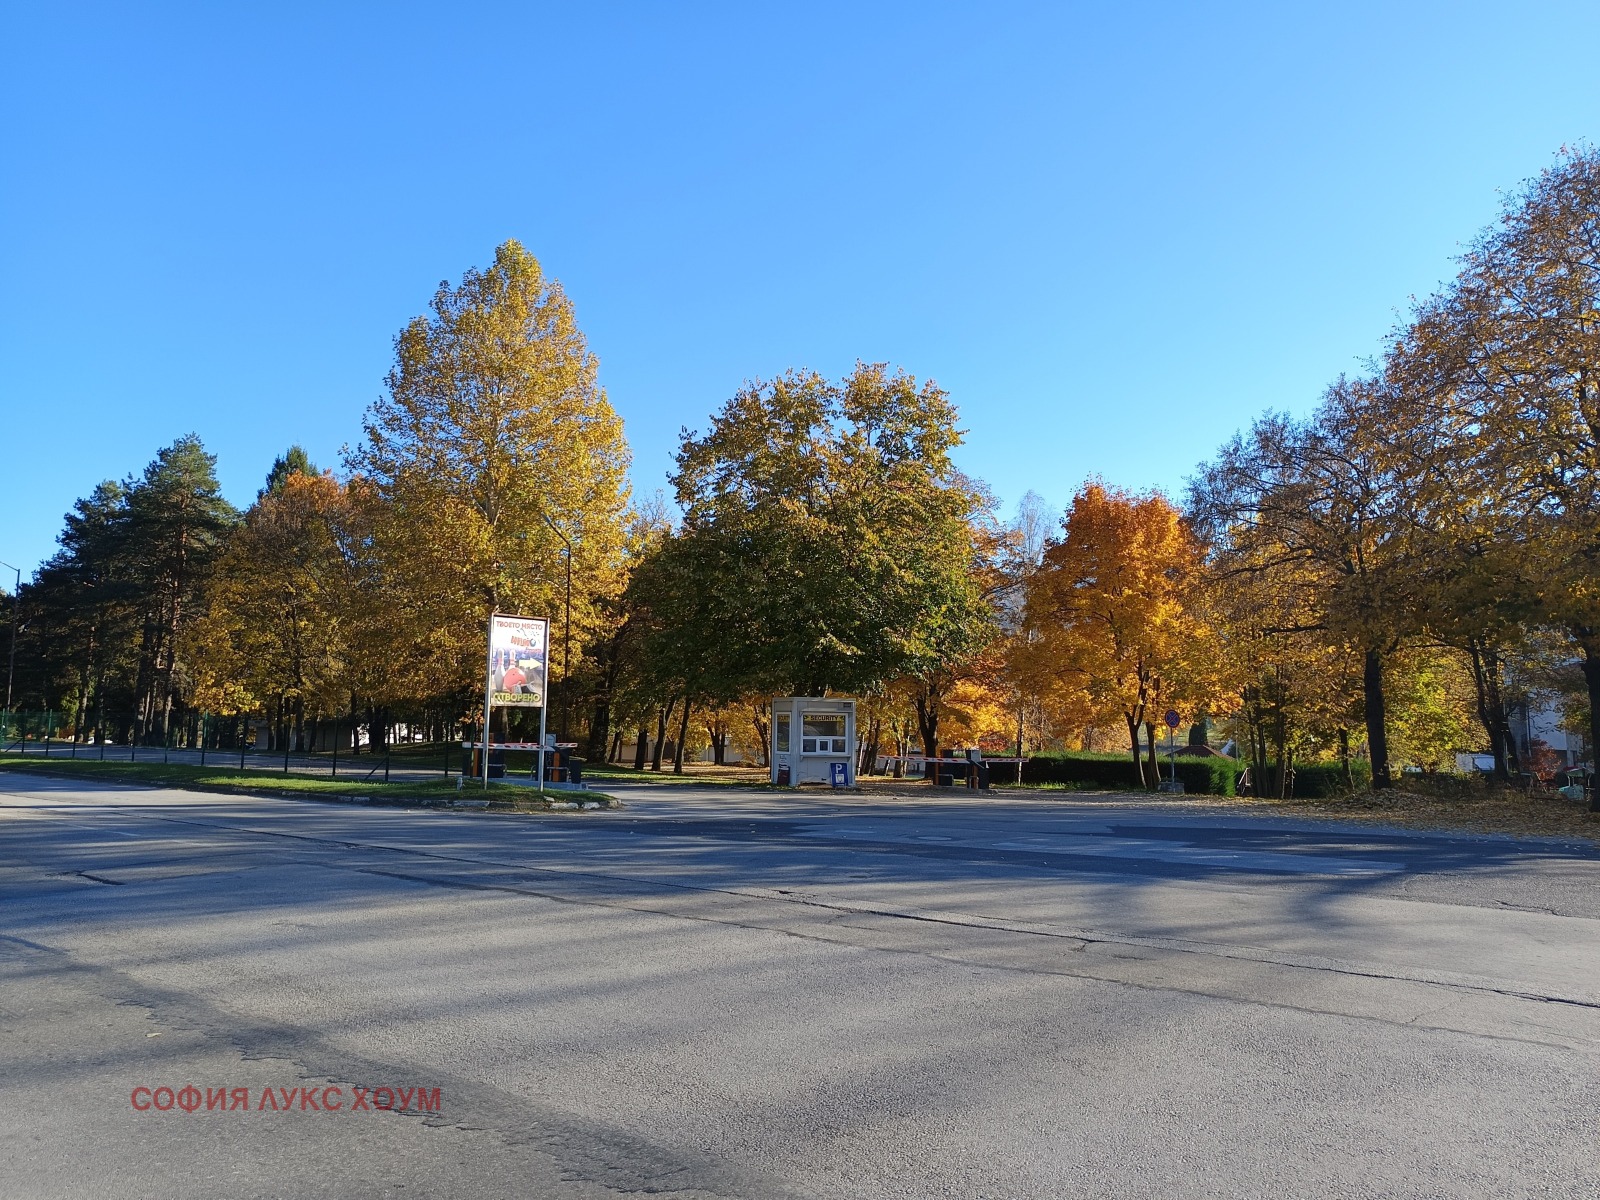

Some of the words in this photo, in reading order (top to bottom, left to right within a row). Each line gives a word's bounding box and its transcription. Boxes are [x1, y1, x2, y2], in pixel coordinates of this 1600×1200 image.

[496, 620, 520, 628] ТВОЕТО
[521, 622, 543, 630] МЯСТО
[836, 763, 842, 774] P
